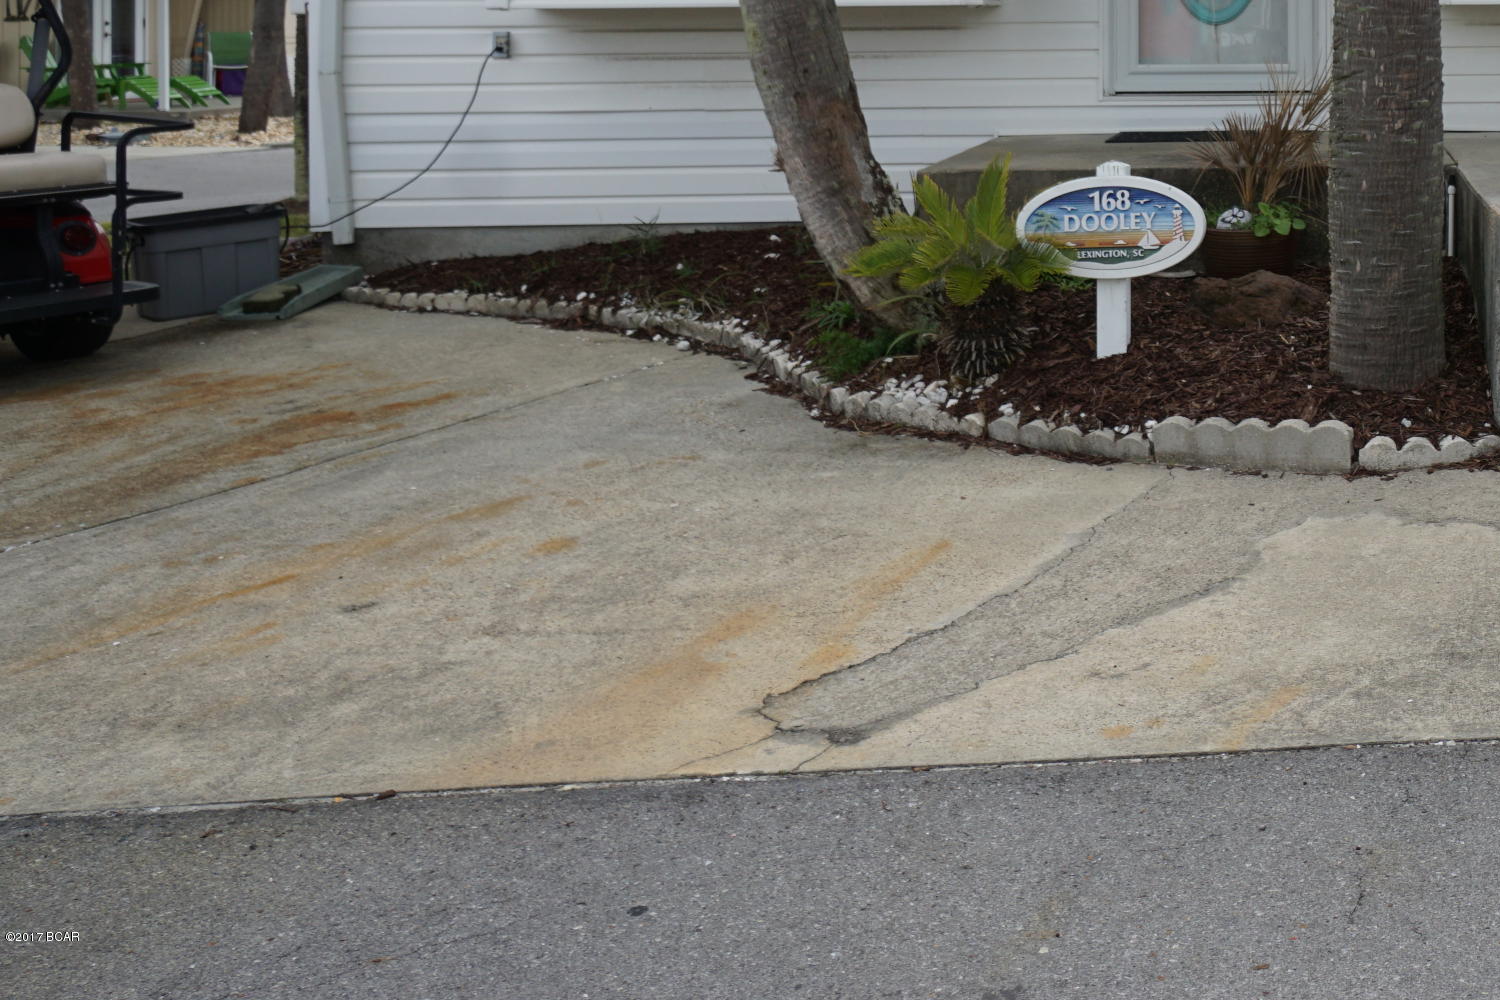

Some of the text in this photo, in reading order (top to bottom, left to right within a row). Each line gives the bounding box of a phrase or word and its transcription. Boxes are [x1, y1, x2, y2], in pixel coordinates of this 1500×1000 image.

[1088, 189, 1131, 212] 168
[1063, 211, 1155, 232] DOOLEY
[1077, 248, 1144, 259] LEXINGTON, SC
